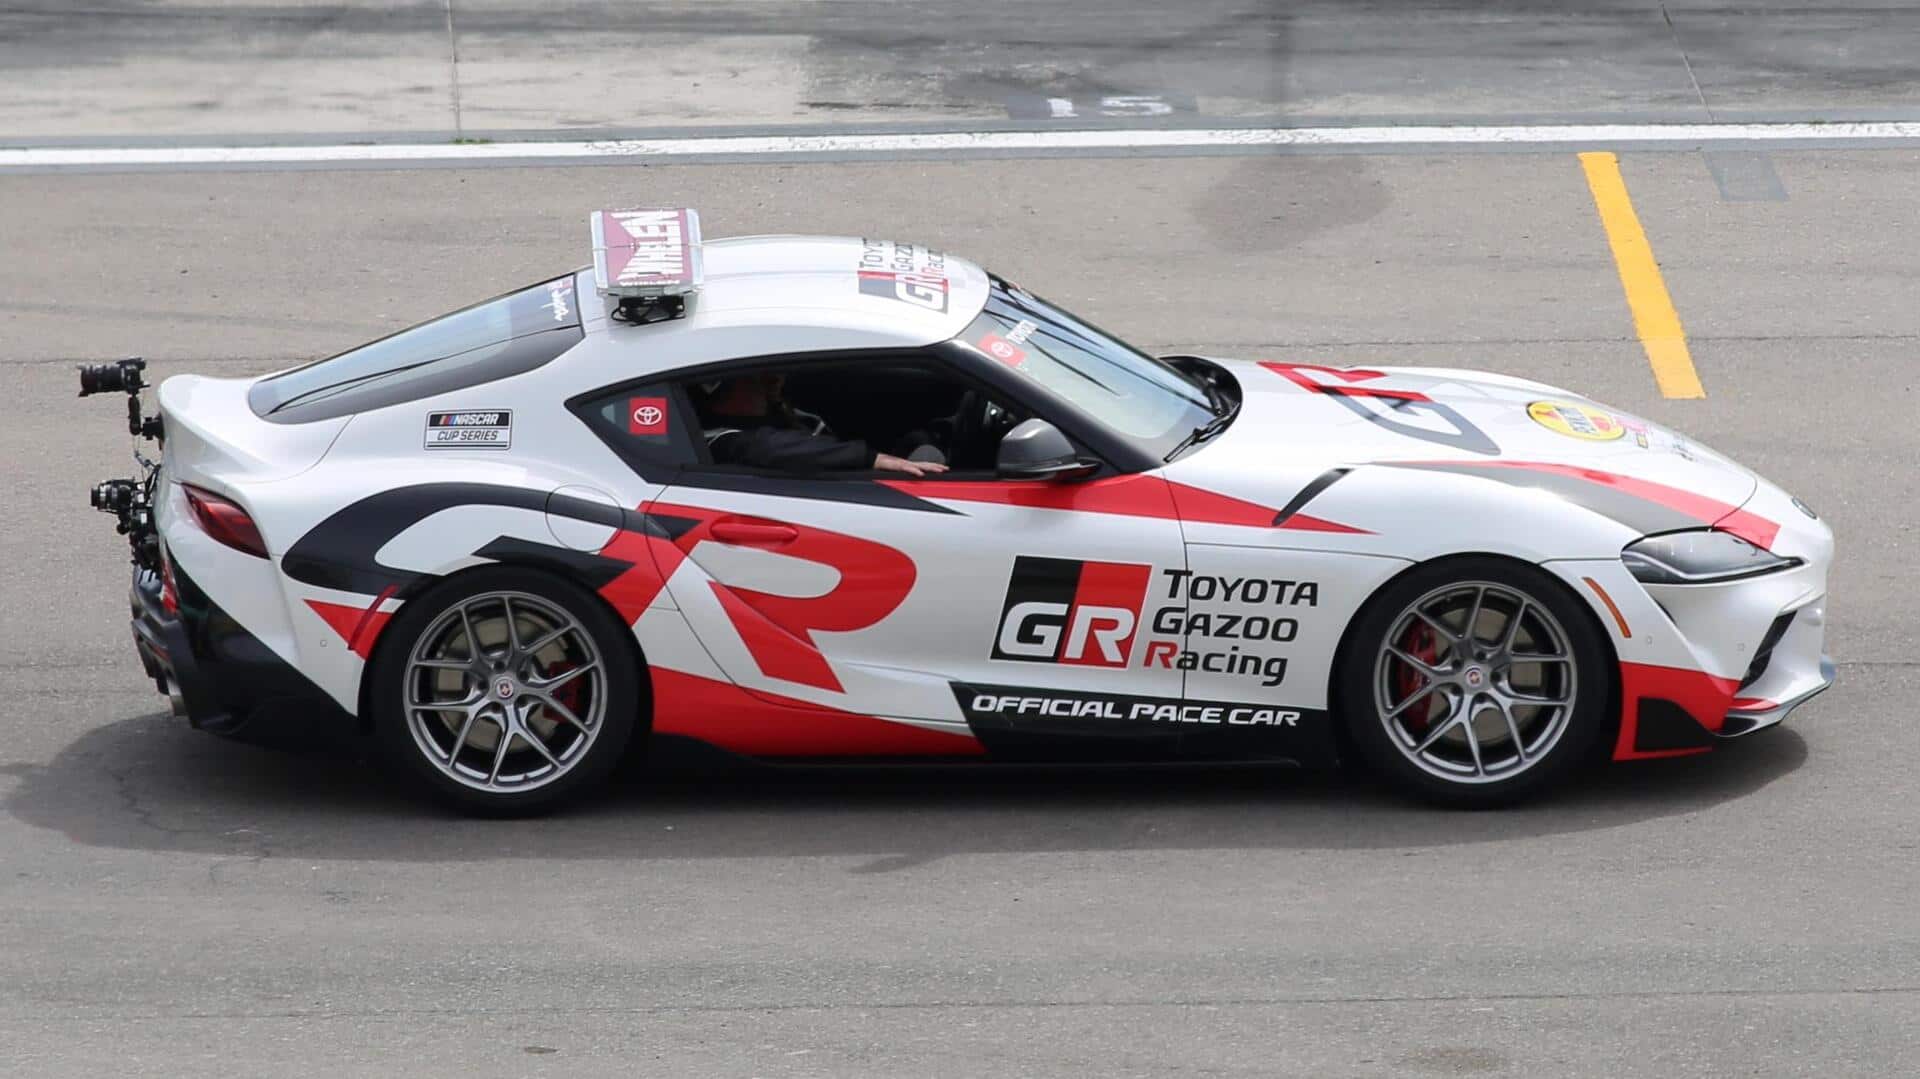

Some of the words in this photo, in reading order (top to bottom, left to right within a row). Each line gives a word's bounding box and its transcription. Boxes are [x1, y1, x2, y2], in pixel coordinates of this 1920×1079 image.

[609, 210, 684, 280] WHELEN
[437, 431, 460, 441] CUP
[460, 430, 499, 441] SERIES
[453, 414, 500, 425] NASCAR
[998, 600, 1137, 665] GR
[1142, 640, 1289, 687] Racing
[971, 694, 1123, 719] OFFICIAL
[1128, 703, 1225, 724] PACE
[1228, 708, 1301, 727] CAR
